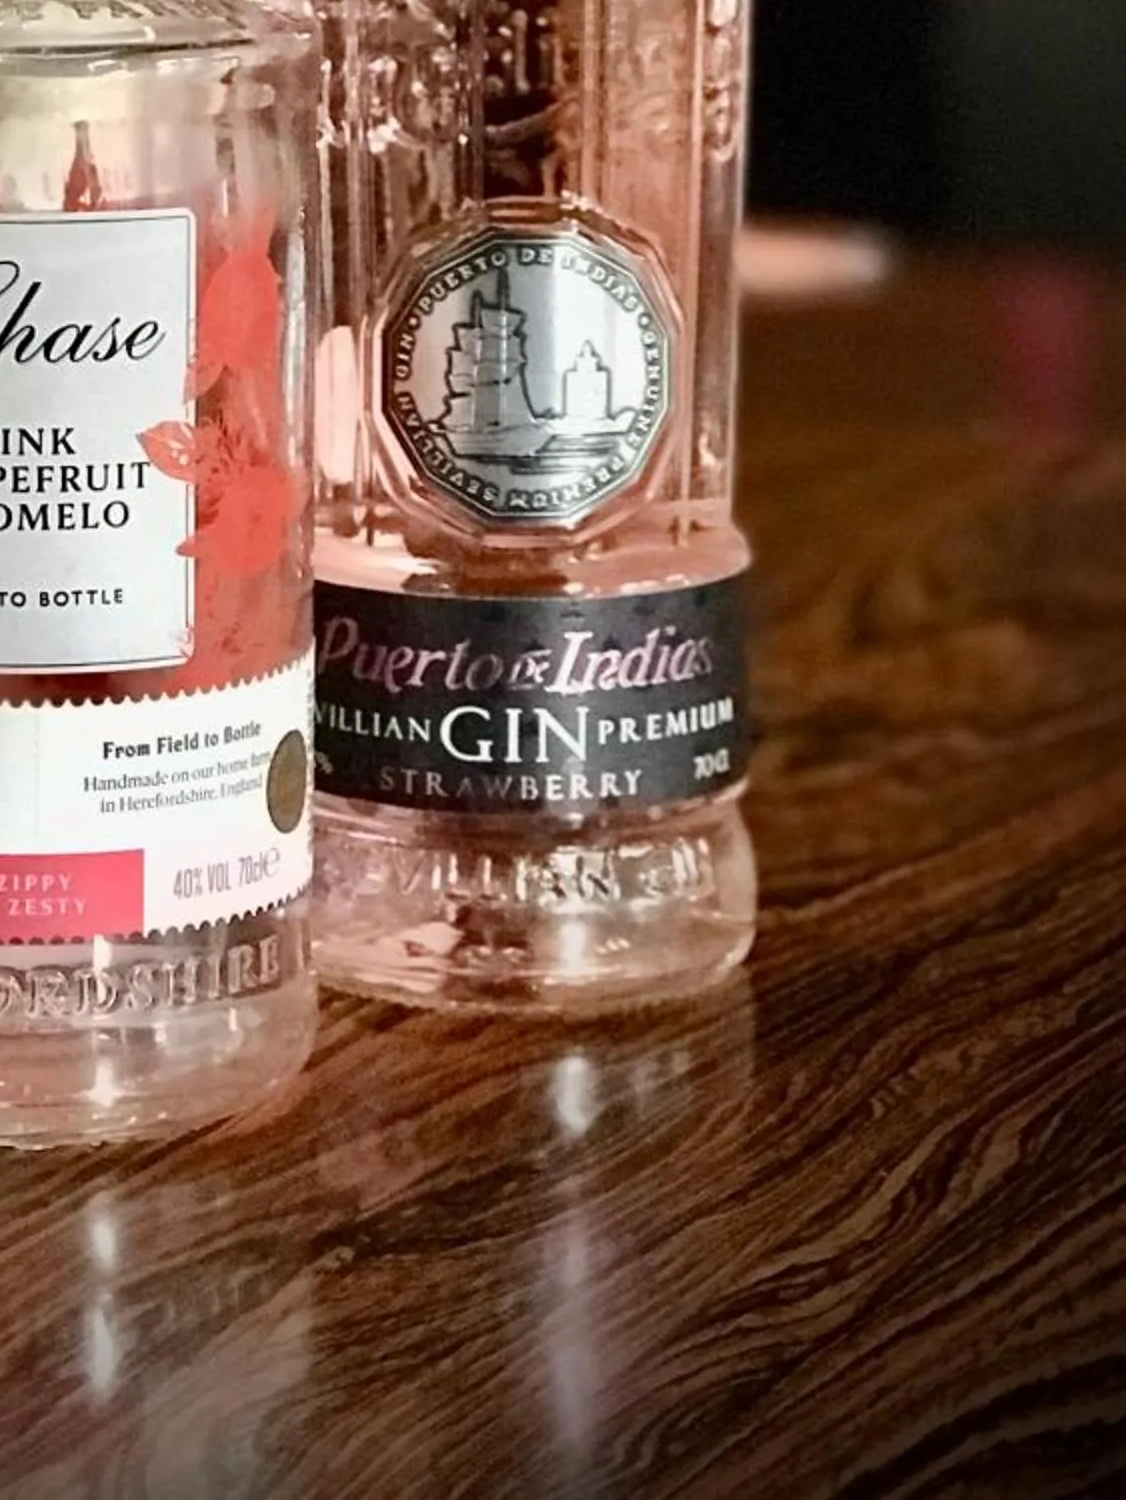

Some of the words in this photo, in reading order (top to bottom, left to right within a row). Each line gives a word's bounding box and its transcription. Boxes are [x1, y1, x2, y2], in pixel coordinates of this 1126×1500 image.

[421, 250, 508, 311] PUERTO
[521, 247, 553, 264] DE
[395, 332, 415, 380] GIN
[39, 588, 124, 608] BOTTLE
[318, 614, 505, 695] Puerto
[545, 624, 714, 697] Indias
[103, 740, 151, 760] From
[157, 731, 199, 755] Field
[204, 730, 220, 748] to
[223, 719, 262, 744] Bottle
[314, 698, 431, 743] VILLIAN
[439, 704, 590, 764] GIN
[598, 695, 735, 746] PREMIUM
[83, 769, 169, 792] Handmade
[171, 770, 189, 783] on
[191, 766, 215, 782] our
[217, 755, 248, 776] home
[379, 766, 643, 801] STRAWBERRY
[100, 799, 116, 814] in
[173, 866, 203, 900] 40%
[207, 861, 232, 894] VOL
[8, 897, 88, 917] ZESTY
